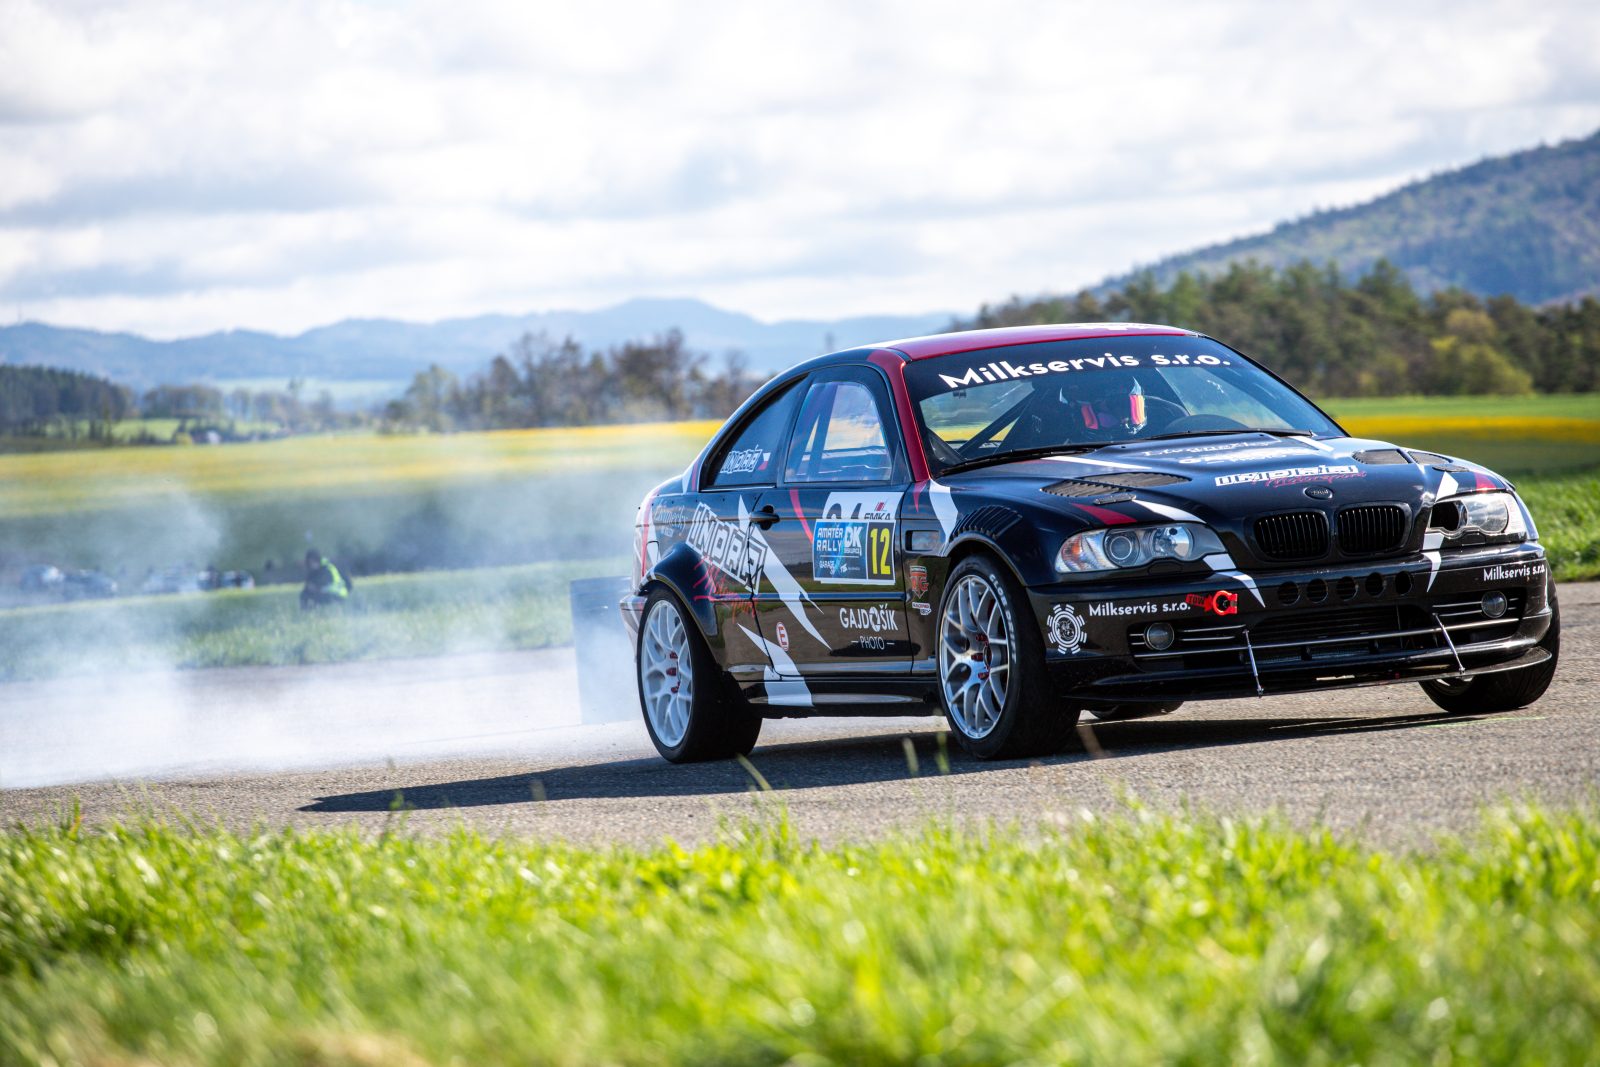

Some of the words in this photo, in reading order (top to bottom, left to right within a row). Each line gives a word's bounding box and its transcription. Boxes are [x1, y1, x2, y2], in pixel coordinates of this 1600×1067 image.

[939, 352, 1139, 388] Milkservis
[1150, 353, 1231, 366] s.r.o.
[817, 524, 843, 538] AMATÉR
[816, 540, 843, 552] RALLY
[870, 528, 891, 575] 12
[1483, 565, 1530, 582] Milkservis
[1089, 601, 1158, 617] Milkservis
[1162, 602, 1191, 612] s.r.o.
[839, 603, 899, 632] GAJDOŠÍK
[859, 635, 885, 650] PHOTO
